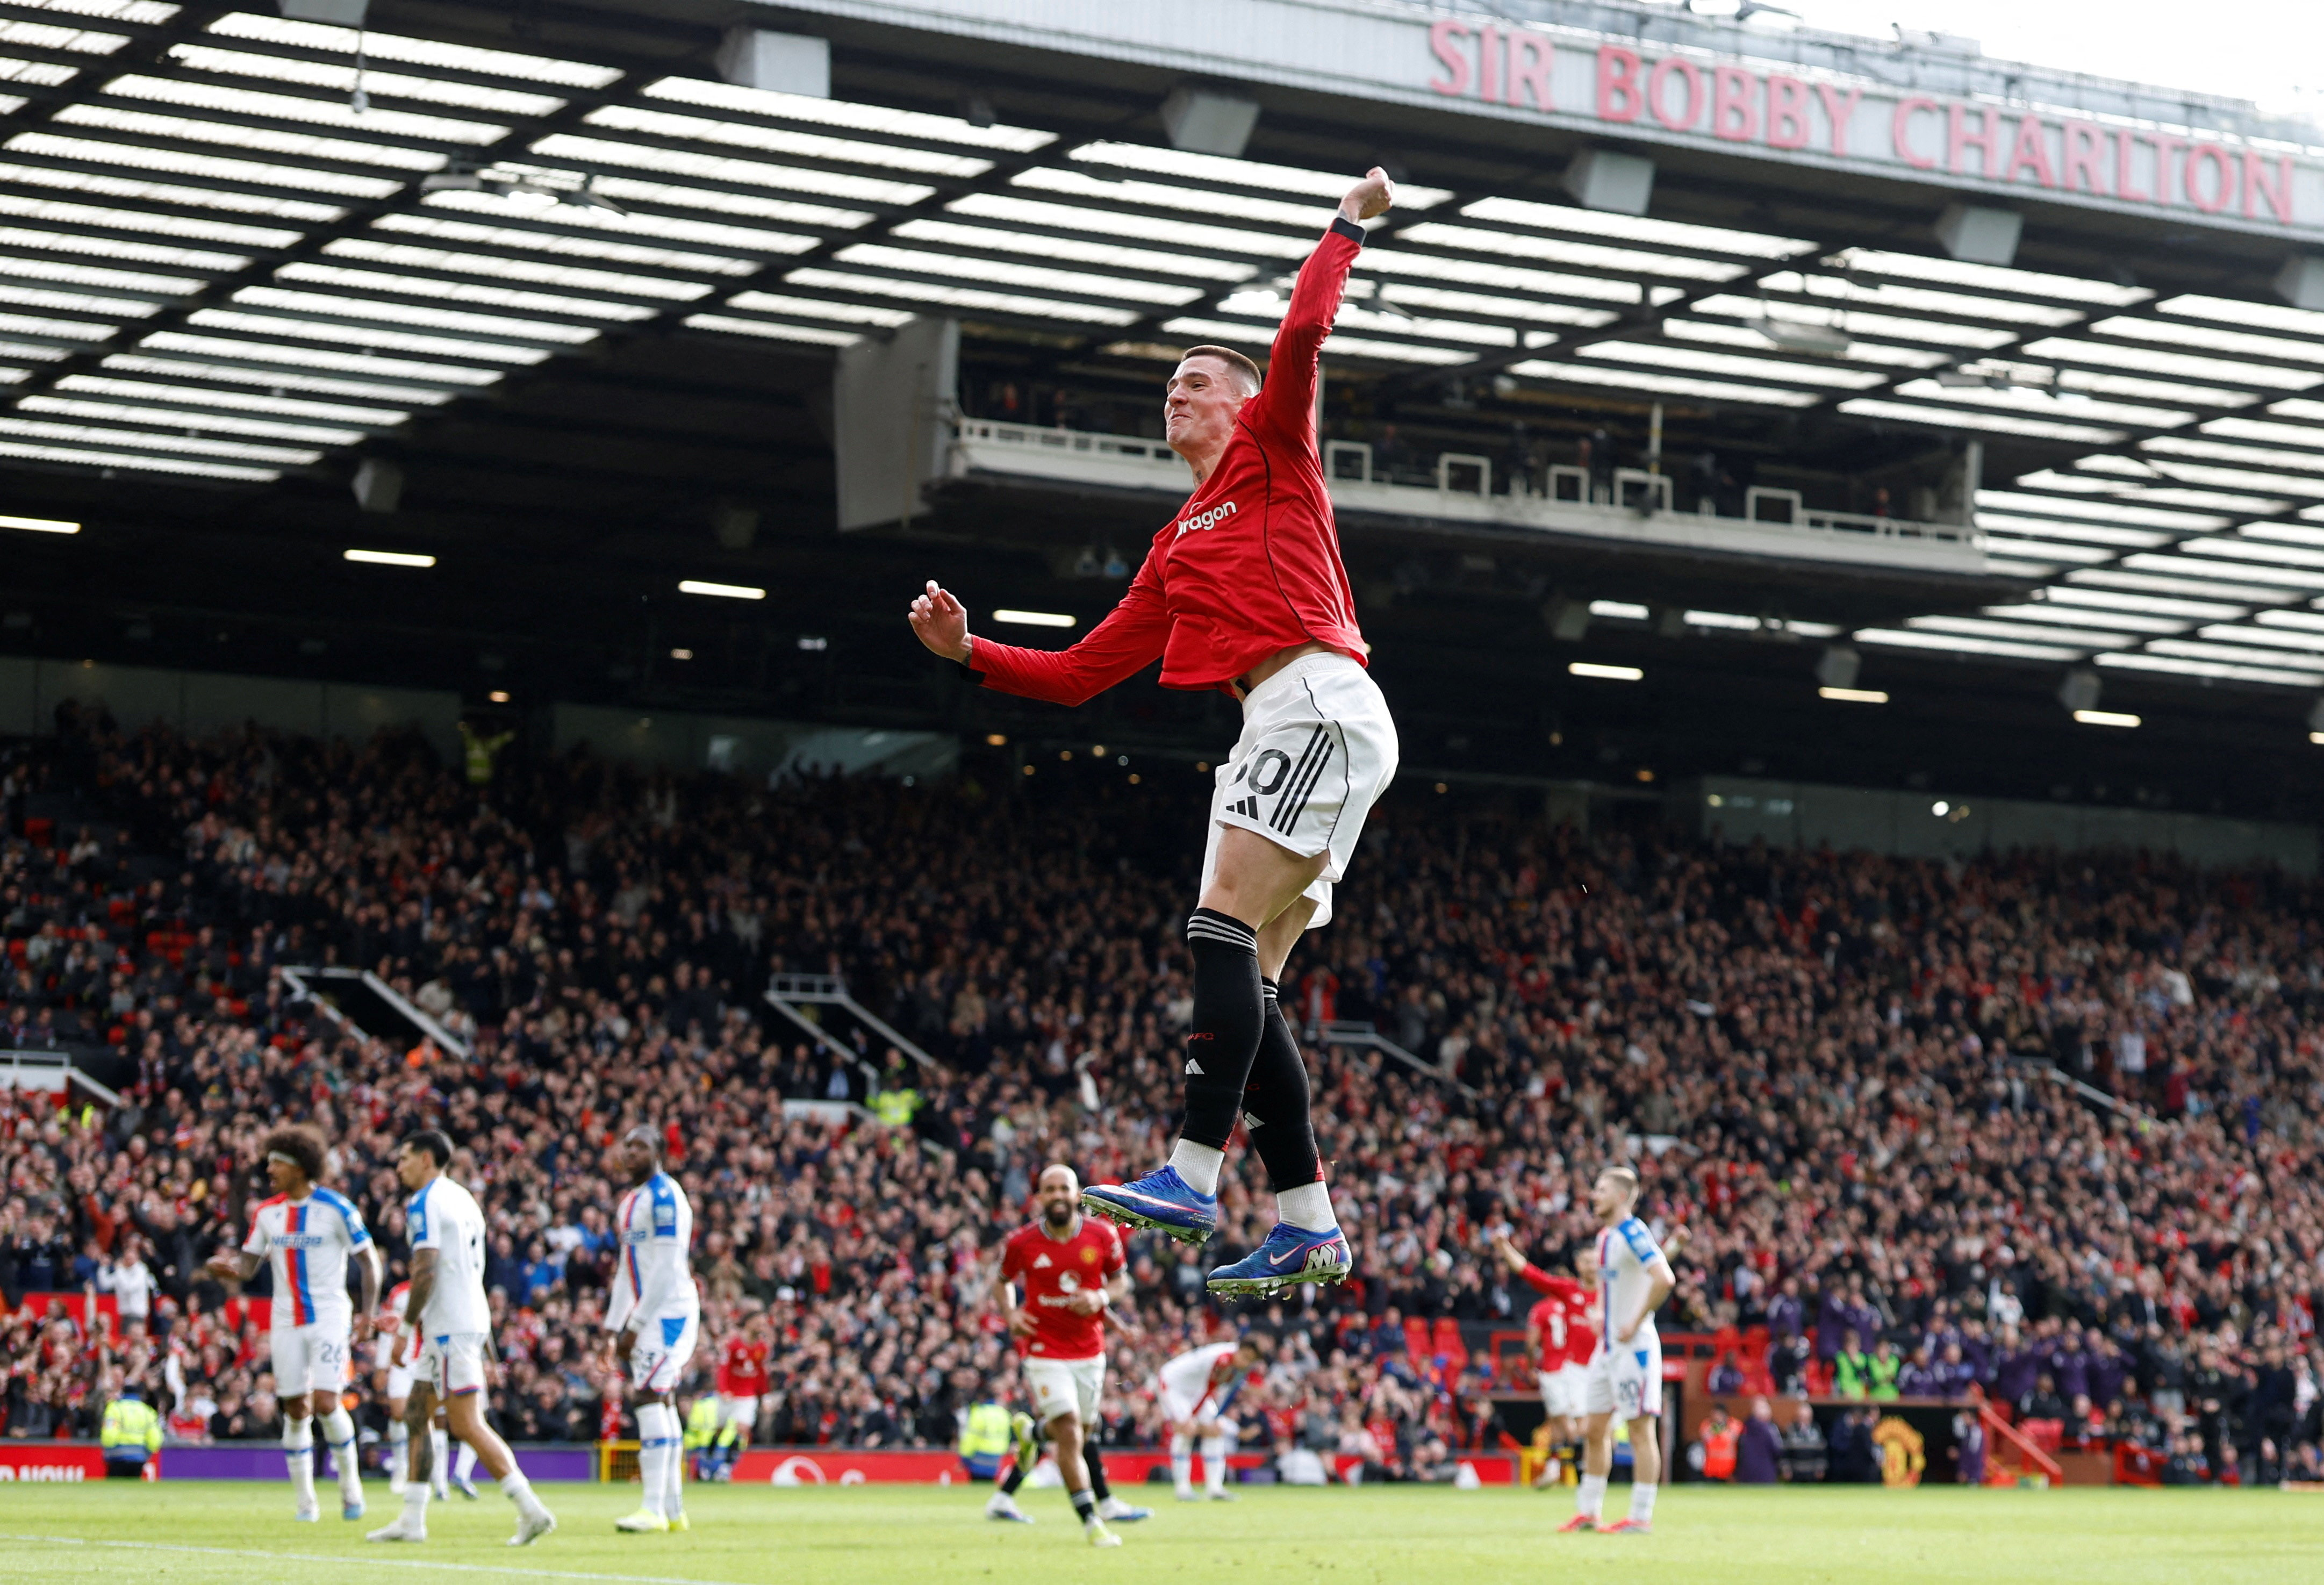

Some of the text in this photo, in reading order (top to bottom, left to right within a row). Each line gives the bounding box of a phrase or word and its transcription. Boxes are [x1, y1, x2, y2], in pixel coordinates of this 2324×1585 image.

[1429, 19, 2294, 226] SIR BOBBY CHARLTON
[1175, 501, 1237, 539] ragon
